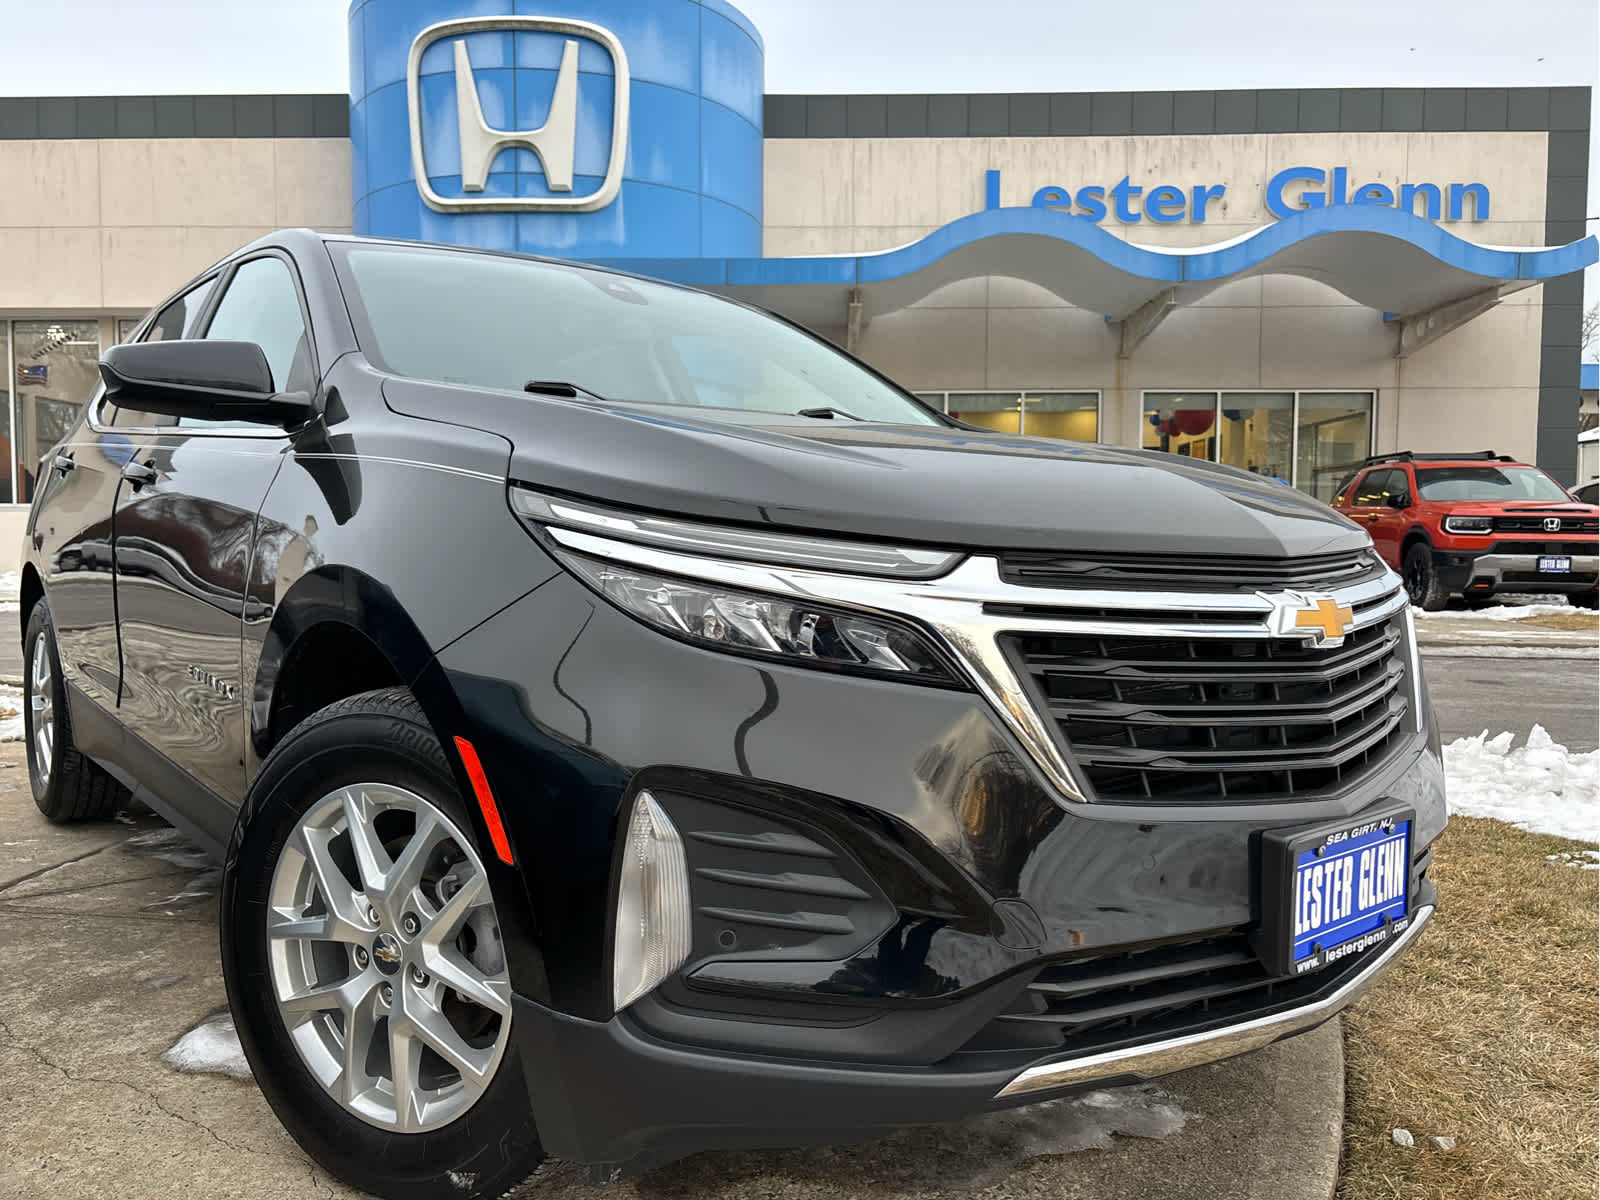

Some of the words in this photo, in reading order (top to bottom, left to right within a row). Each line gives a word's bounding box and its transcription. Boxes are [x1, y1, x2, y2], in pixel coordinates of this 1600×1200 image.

[1266, 166, 1490, 221] Glenn
[1326, 831, 1348, 846] SEA
[1380, 816, 1393, 829] NJ
[1294, 855, 1354, 937] LESTER
[1358, 837, 1405, 912] GLENN
